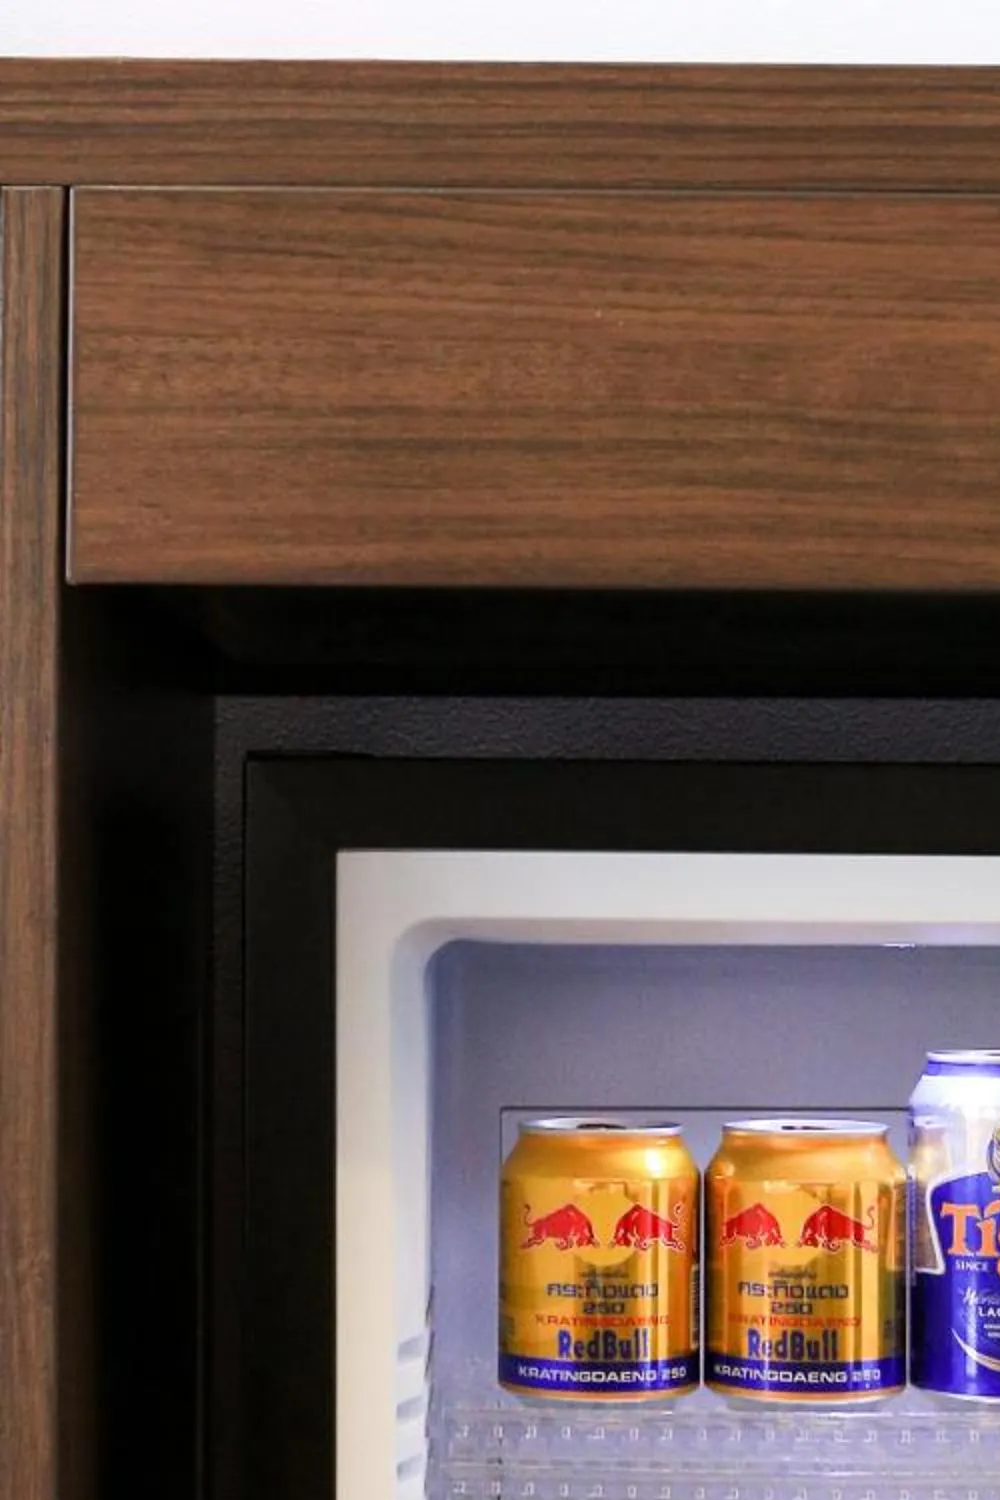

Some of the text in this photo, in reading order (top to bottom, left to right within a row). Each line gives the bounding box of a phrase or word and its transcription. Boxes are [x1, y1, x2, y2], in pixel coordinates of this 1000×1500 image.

[518, 1365, 687, 1383] KRATINGDAENG 250
[713, 1364, 848, 1384] KRATINGDAENG
